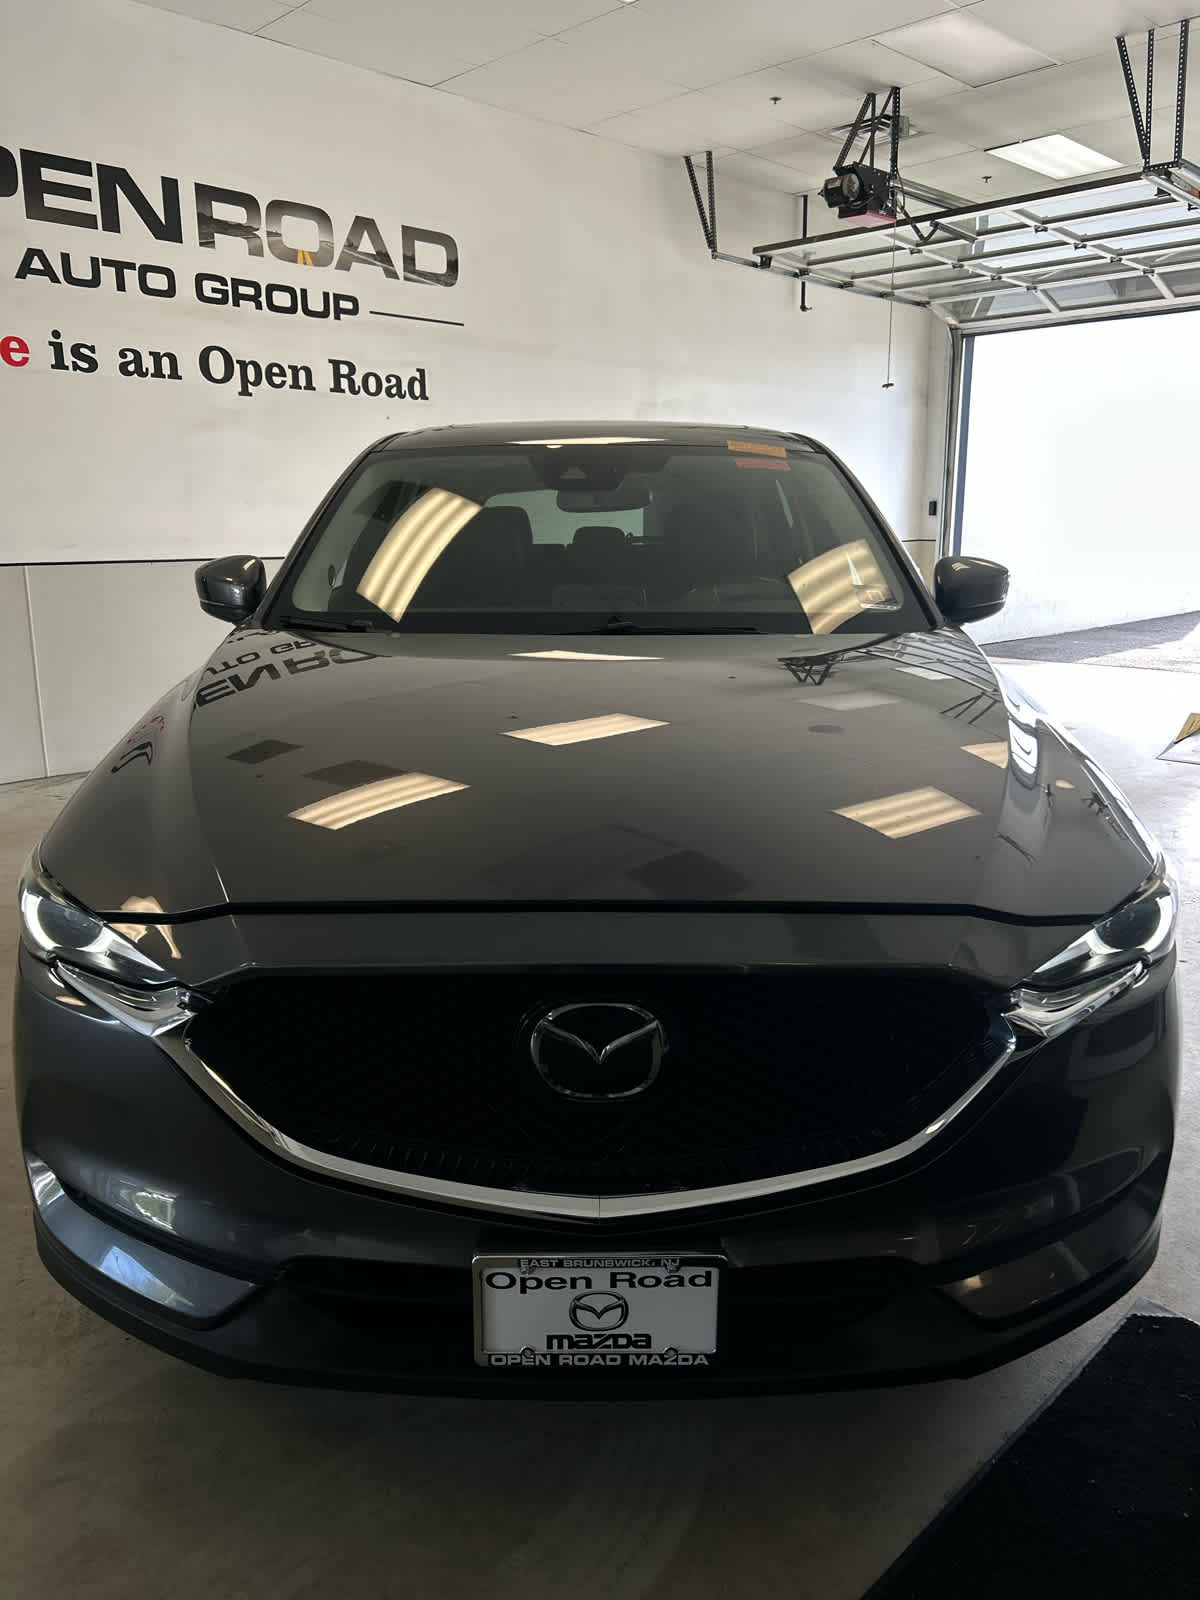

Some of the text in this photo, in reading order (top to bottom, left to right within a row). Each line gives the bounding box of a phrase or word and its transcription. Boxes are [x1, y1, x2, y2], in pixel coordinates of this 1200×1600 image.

[0, 145, 459, 288] EN ROAD
[15, 247, 359, 320] AUTO GROUP
[47, 329, 98, 374] is
[118, 345, 183, 380] an
[199, 345, 316, 397] Open
[328, 358, 429, 401] Road
[520, 1259, 559, 1268] EAST
[662, 1258, 680, 1267] NJ
[485, 1270, 712, 1294] Open Road
[546, 1333, 652, 1350] mazda
[490, 1354, 709, 1366] OPEN ROAD MAZDA
